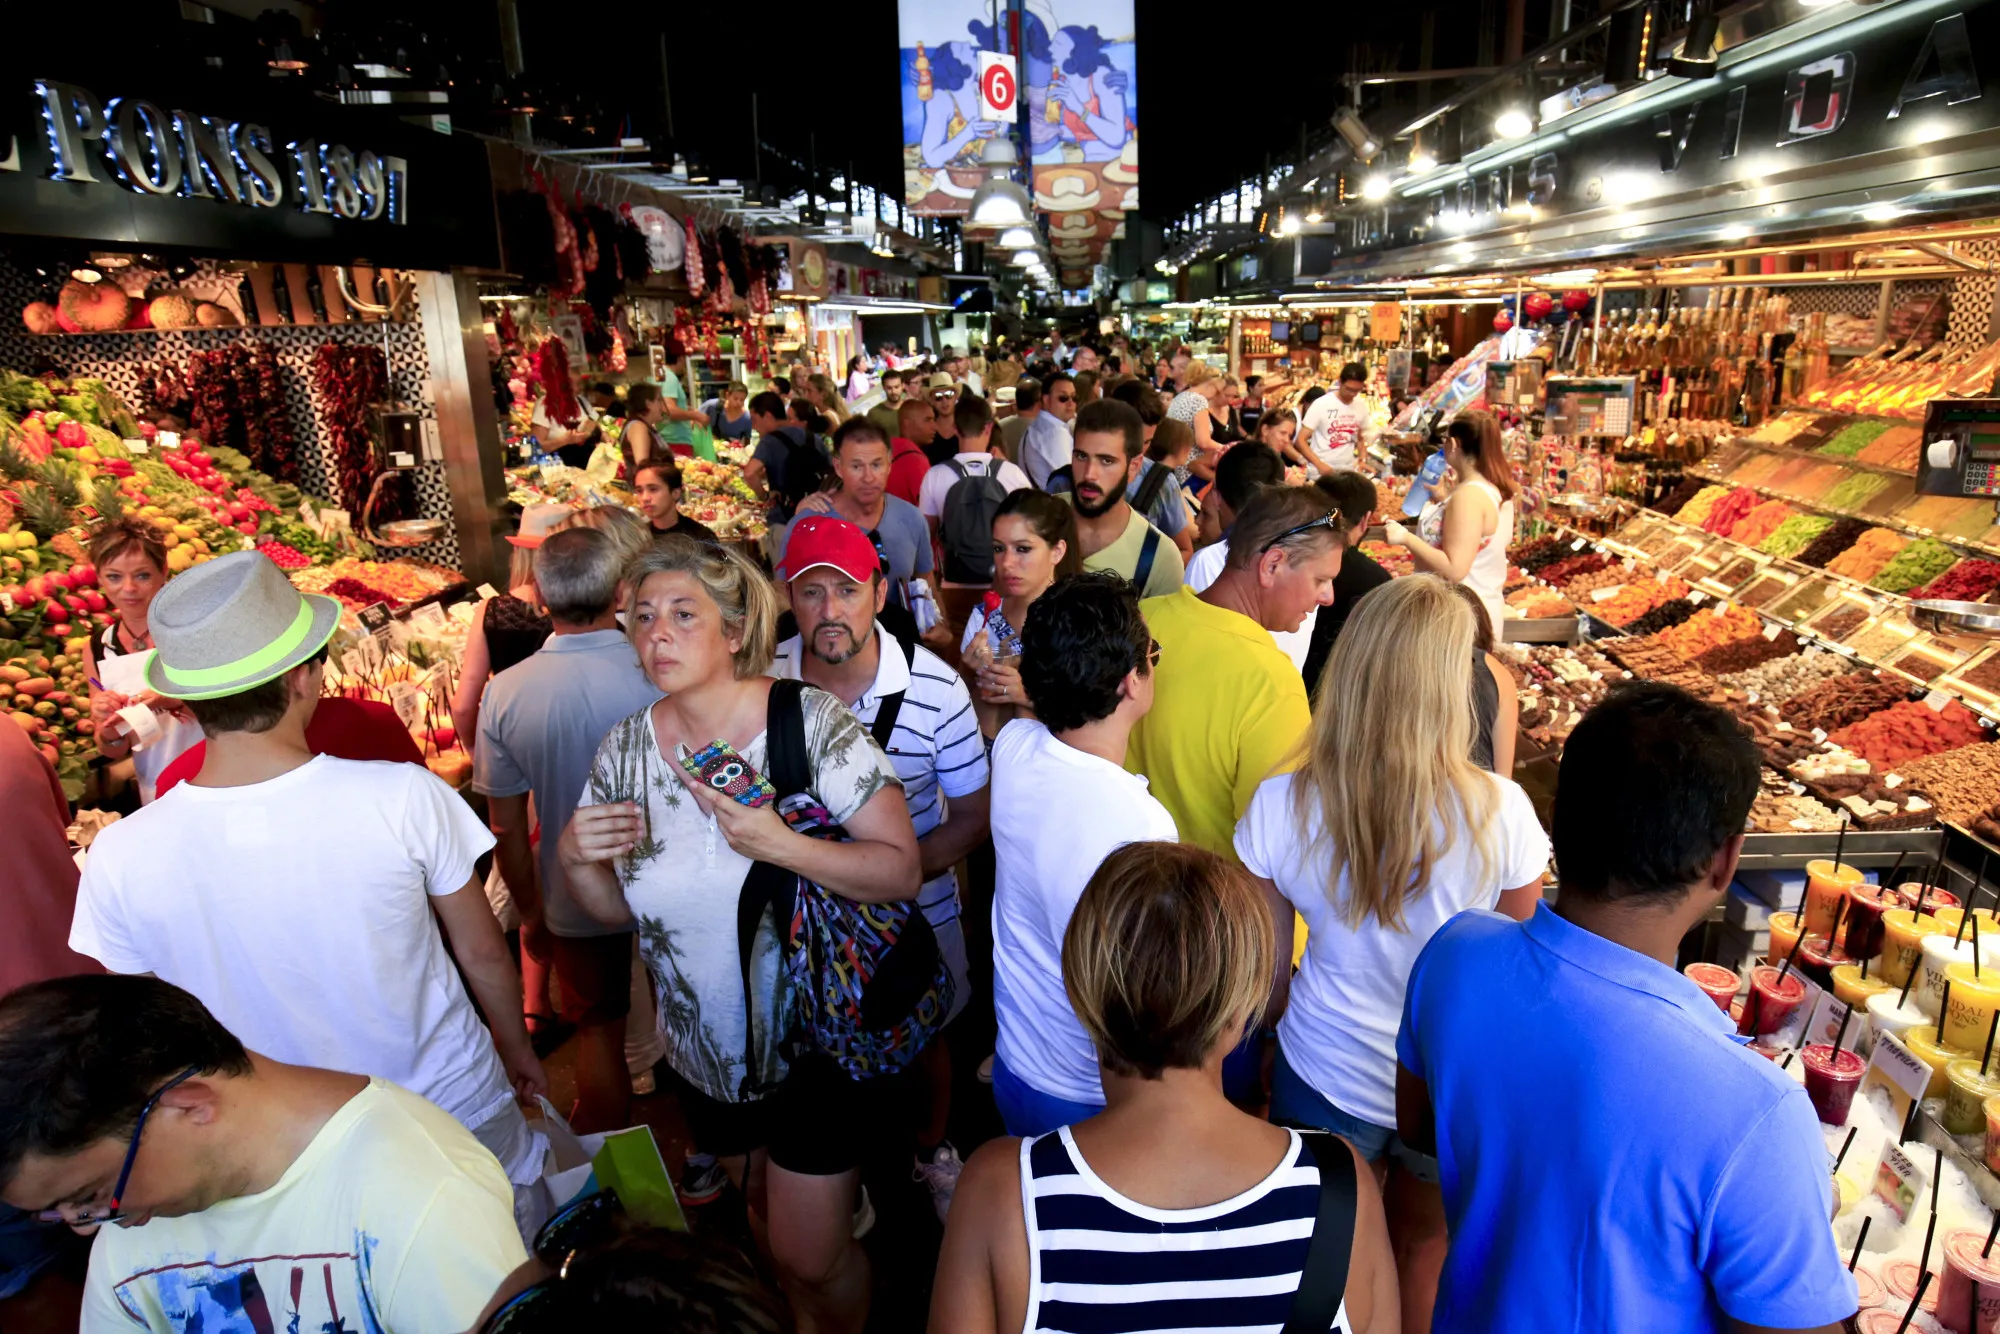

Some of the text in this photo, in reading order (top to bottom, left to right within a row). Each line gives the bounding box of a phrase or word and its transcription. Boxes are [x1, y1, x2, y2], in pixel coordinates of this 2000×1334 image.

[992, 71, 1007, 103] 6
[34, 77, 407, 225] PONS 1897
[1327, 409, 1339, 419] 77
